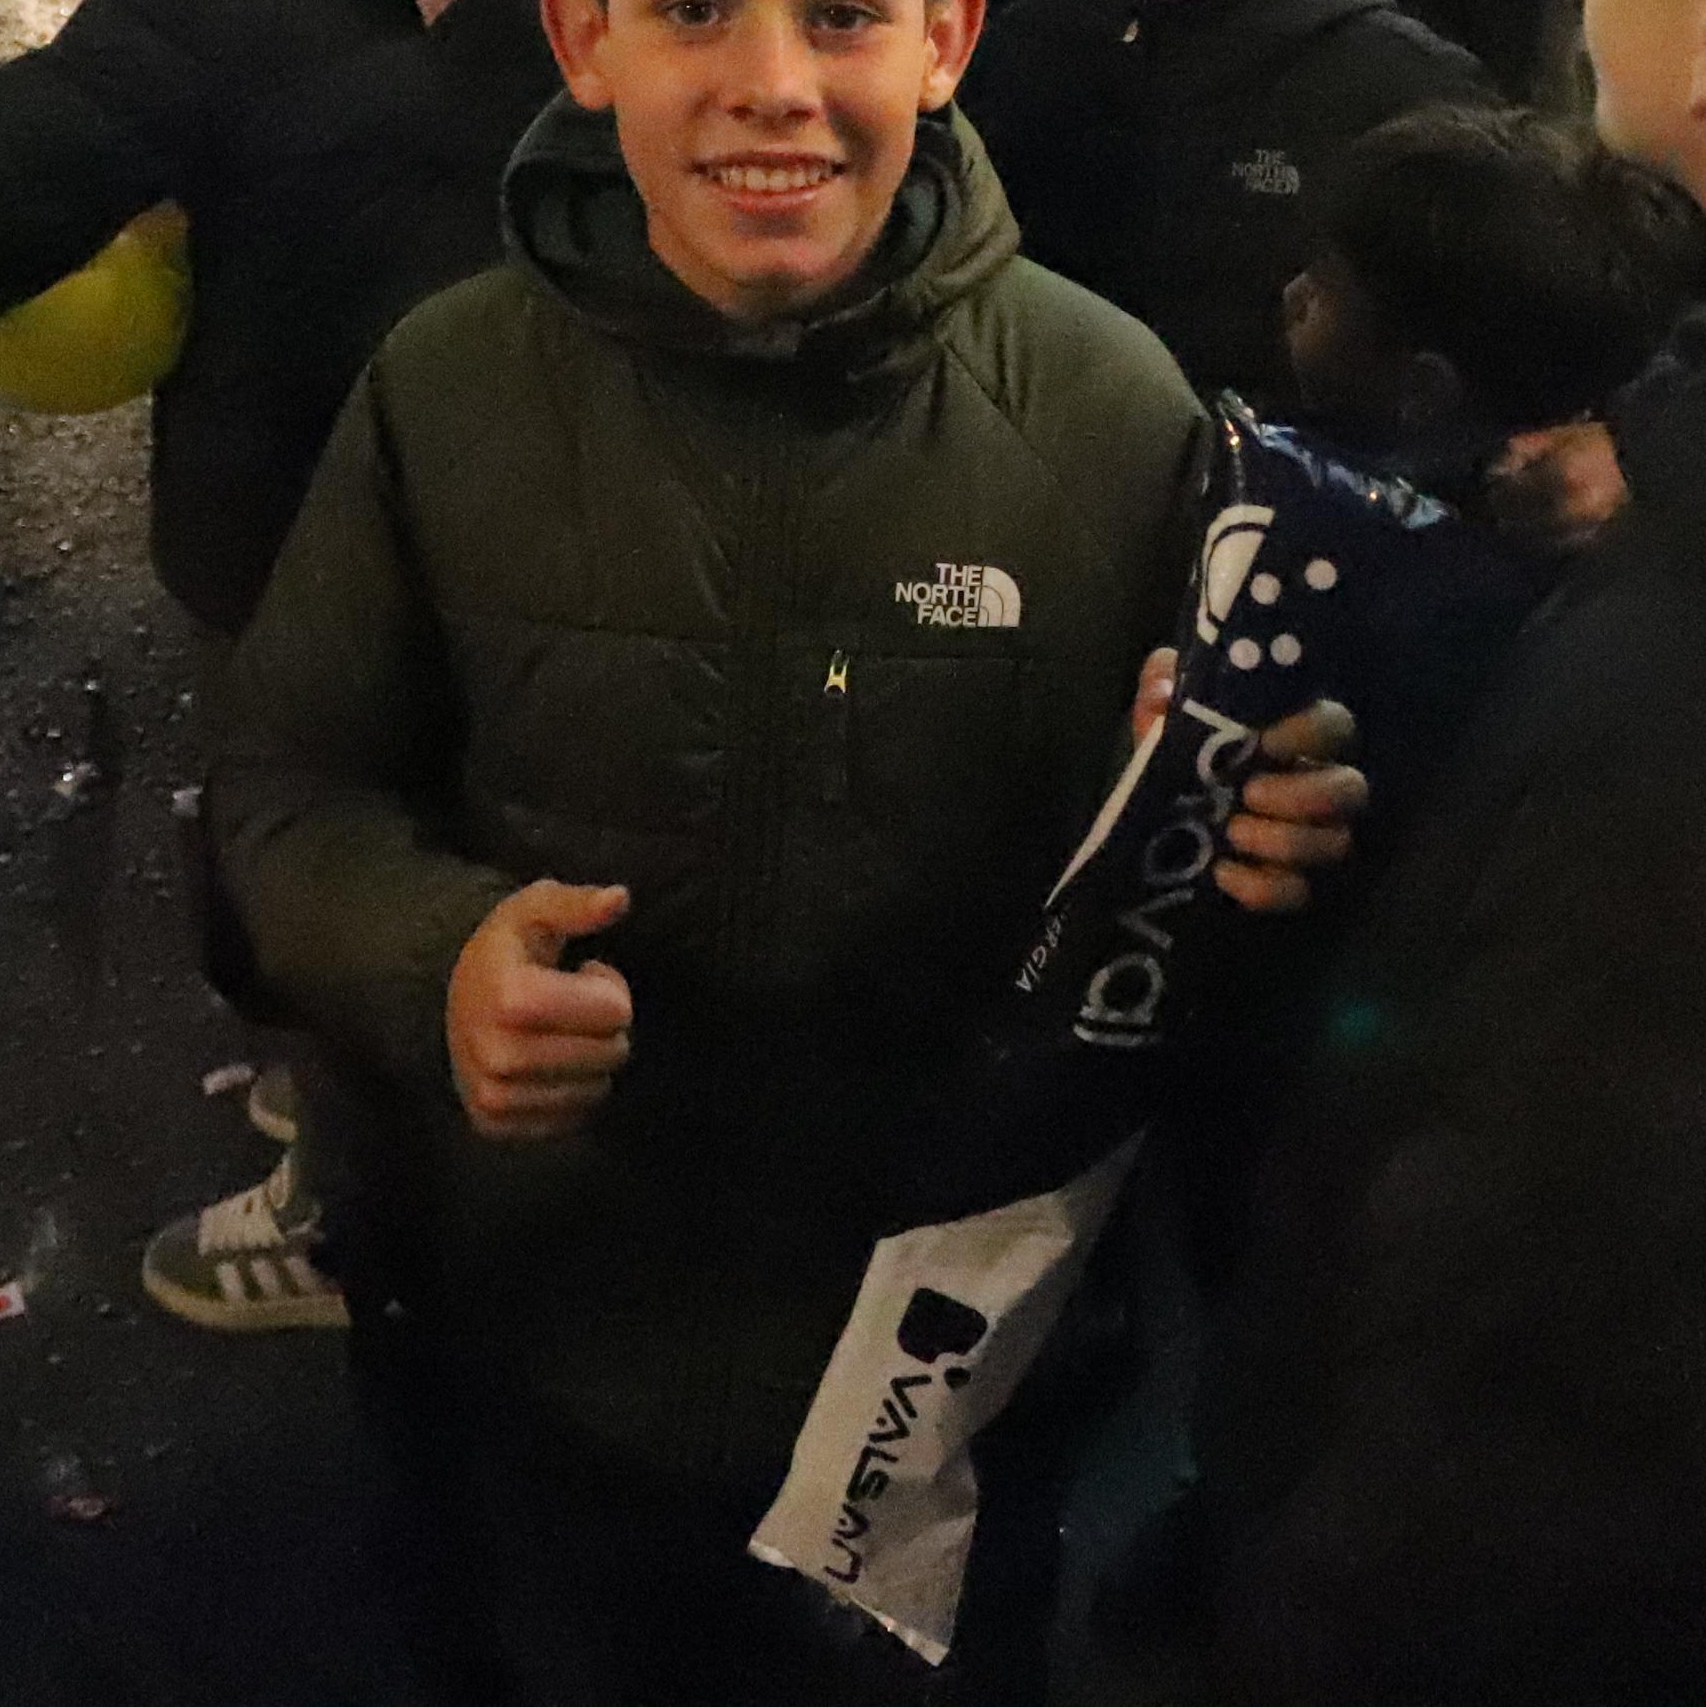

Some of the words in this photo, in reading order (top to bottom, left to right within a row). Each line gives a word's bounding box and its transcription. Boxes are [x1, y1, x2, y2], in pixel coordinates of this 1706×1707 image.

[935, 562, 983, 587] THE
[894, 581, 981, 608] NORTH
[917, 604, 979, 628] FACE
